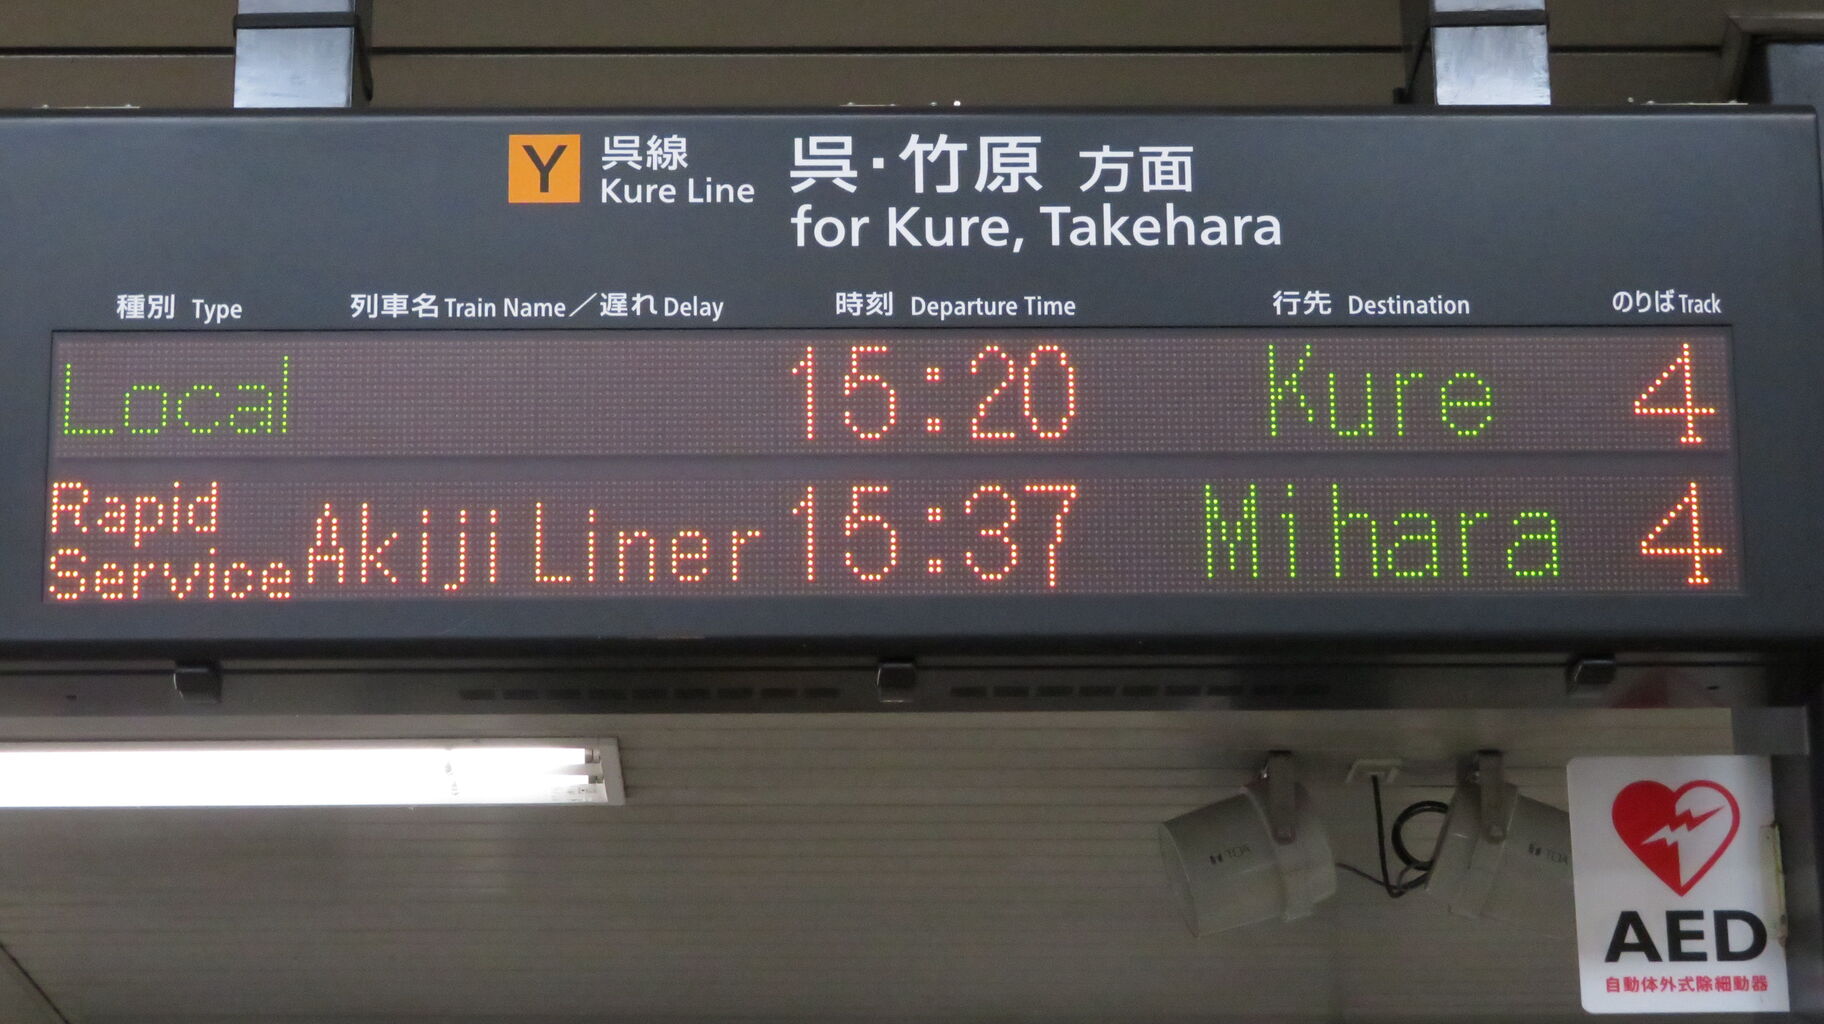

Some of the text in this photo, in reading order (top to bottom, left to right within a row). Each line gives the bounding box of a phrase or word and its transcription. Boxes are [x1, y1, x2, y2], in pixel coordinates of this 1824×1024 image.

[523, 145, 566, 193] Y
[602, 134, 688, 170] 呉線
[1079, 145, 1193, 192] 方面
[602, 177, 754, 203] Kure Line
[791, 203, 1281, 253] for Kure, Takehara
[117, 294, 175, 319] 種別
[192, 299, 242, 324] Type
[351, 293, 438, 318] 列車名
[444, 298, 496, 317] Train
[665, 296, 724, 321] Delay
[836, 291, 893, 316] 時刻
[912, 296, 1075, 320] Departure Time
[1273, 291, 1331, 315] 行先
[1349, 295, 1469, 314] Destination
[1613, 289, 1674, 312] のりば
[1679, 293, 1721, 313] Track
[63, 355, 289, 435] Local
[791, 343, 1079, 442] 15:20
[1268, 344, 1493, 437] Kure
[1632, 342, 1716, 446] 4
[50, 480, 221, 549] Rapid
[791, 482, 1081, 589] 15:37
[1204, 483, 1559, 578] Mihara
[1639, 481, 1724, 586] 4
[305, 501, 763, 593] Akiji Liner
[48, 548, 293, 602] Service
[1604, 909, 1768, 963] AED
[1605, 975, 1769, 993] 自動体外式除細動器
